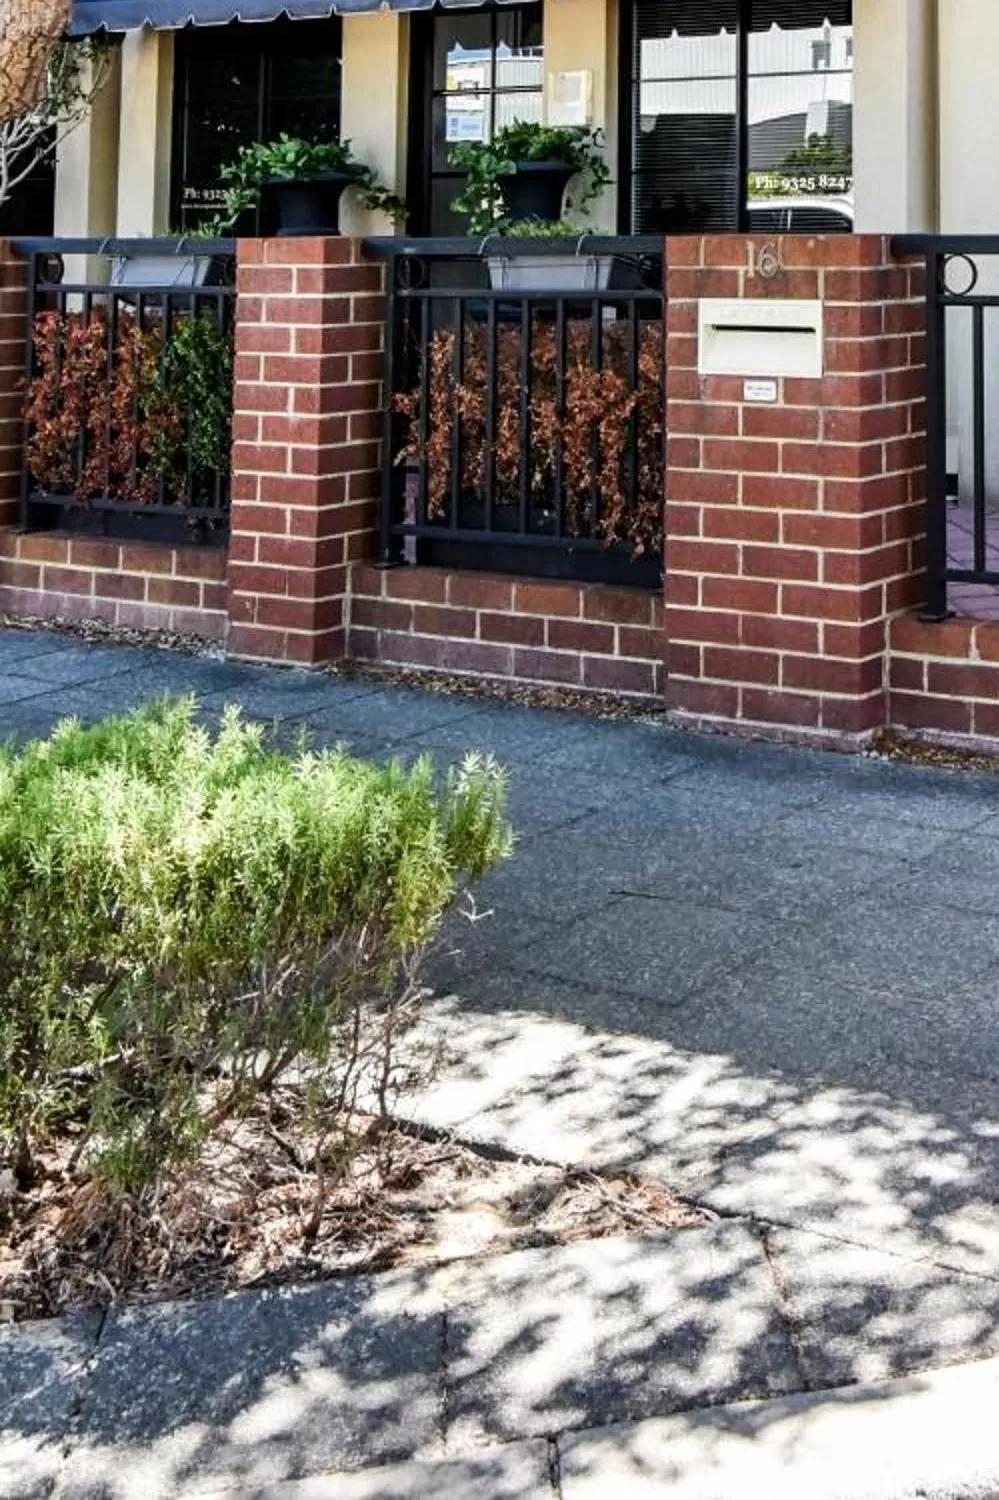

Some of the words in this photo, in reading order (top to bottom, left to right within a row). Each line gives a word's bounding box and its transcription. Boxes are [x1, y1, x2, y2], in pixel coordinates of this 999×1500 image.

[755, 175, 778, 189] Ph:
[781, 177, 816, 191] 9325
[819, 174, 854, 191] 8247
[745, 240, 778, 278] 16
